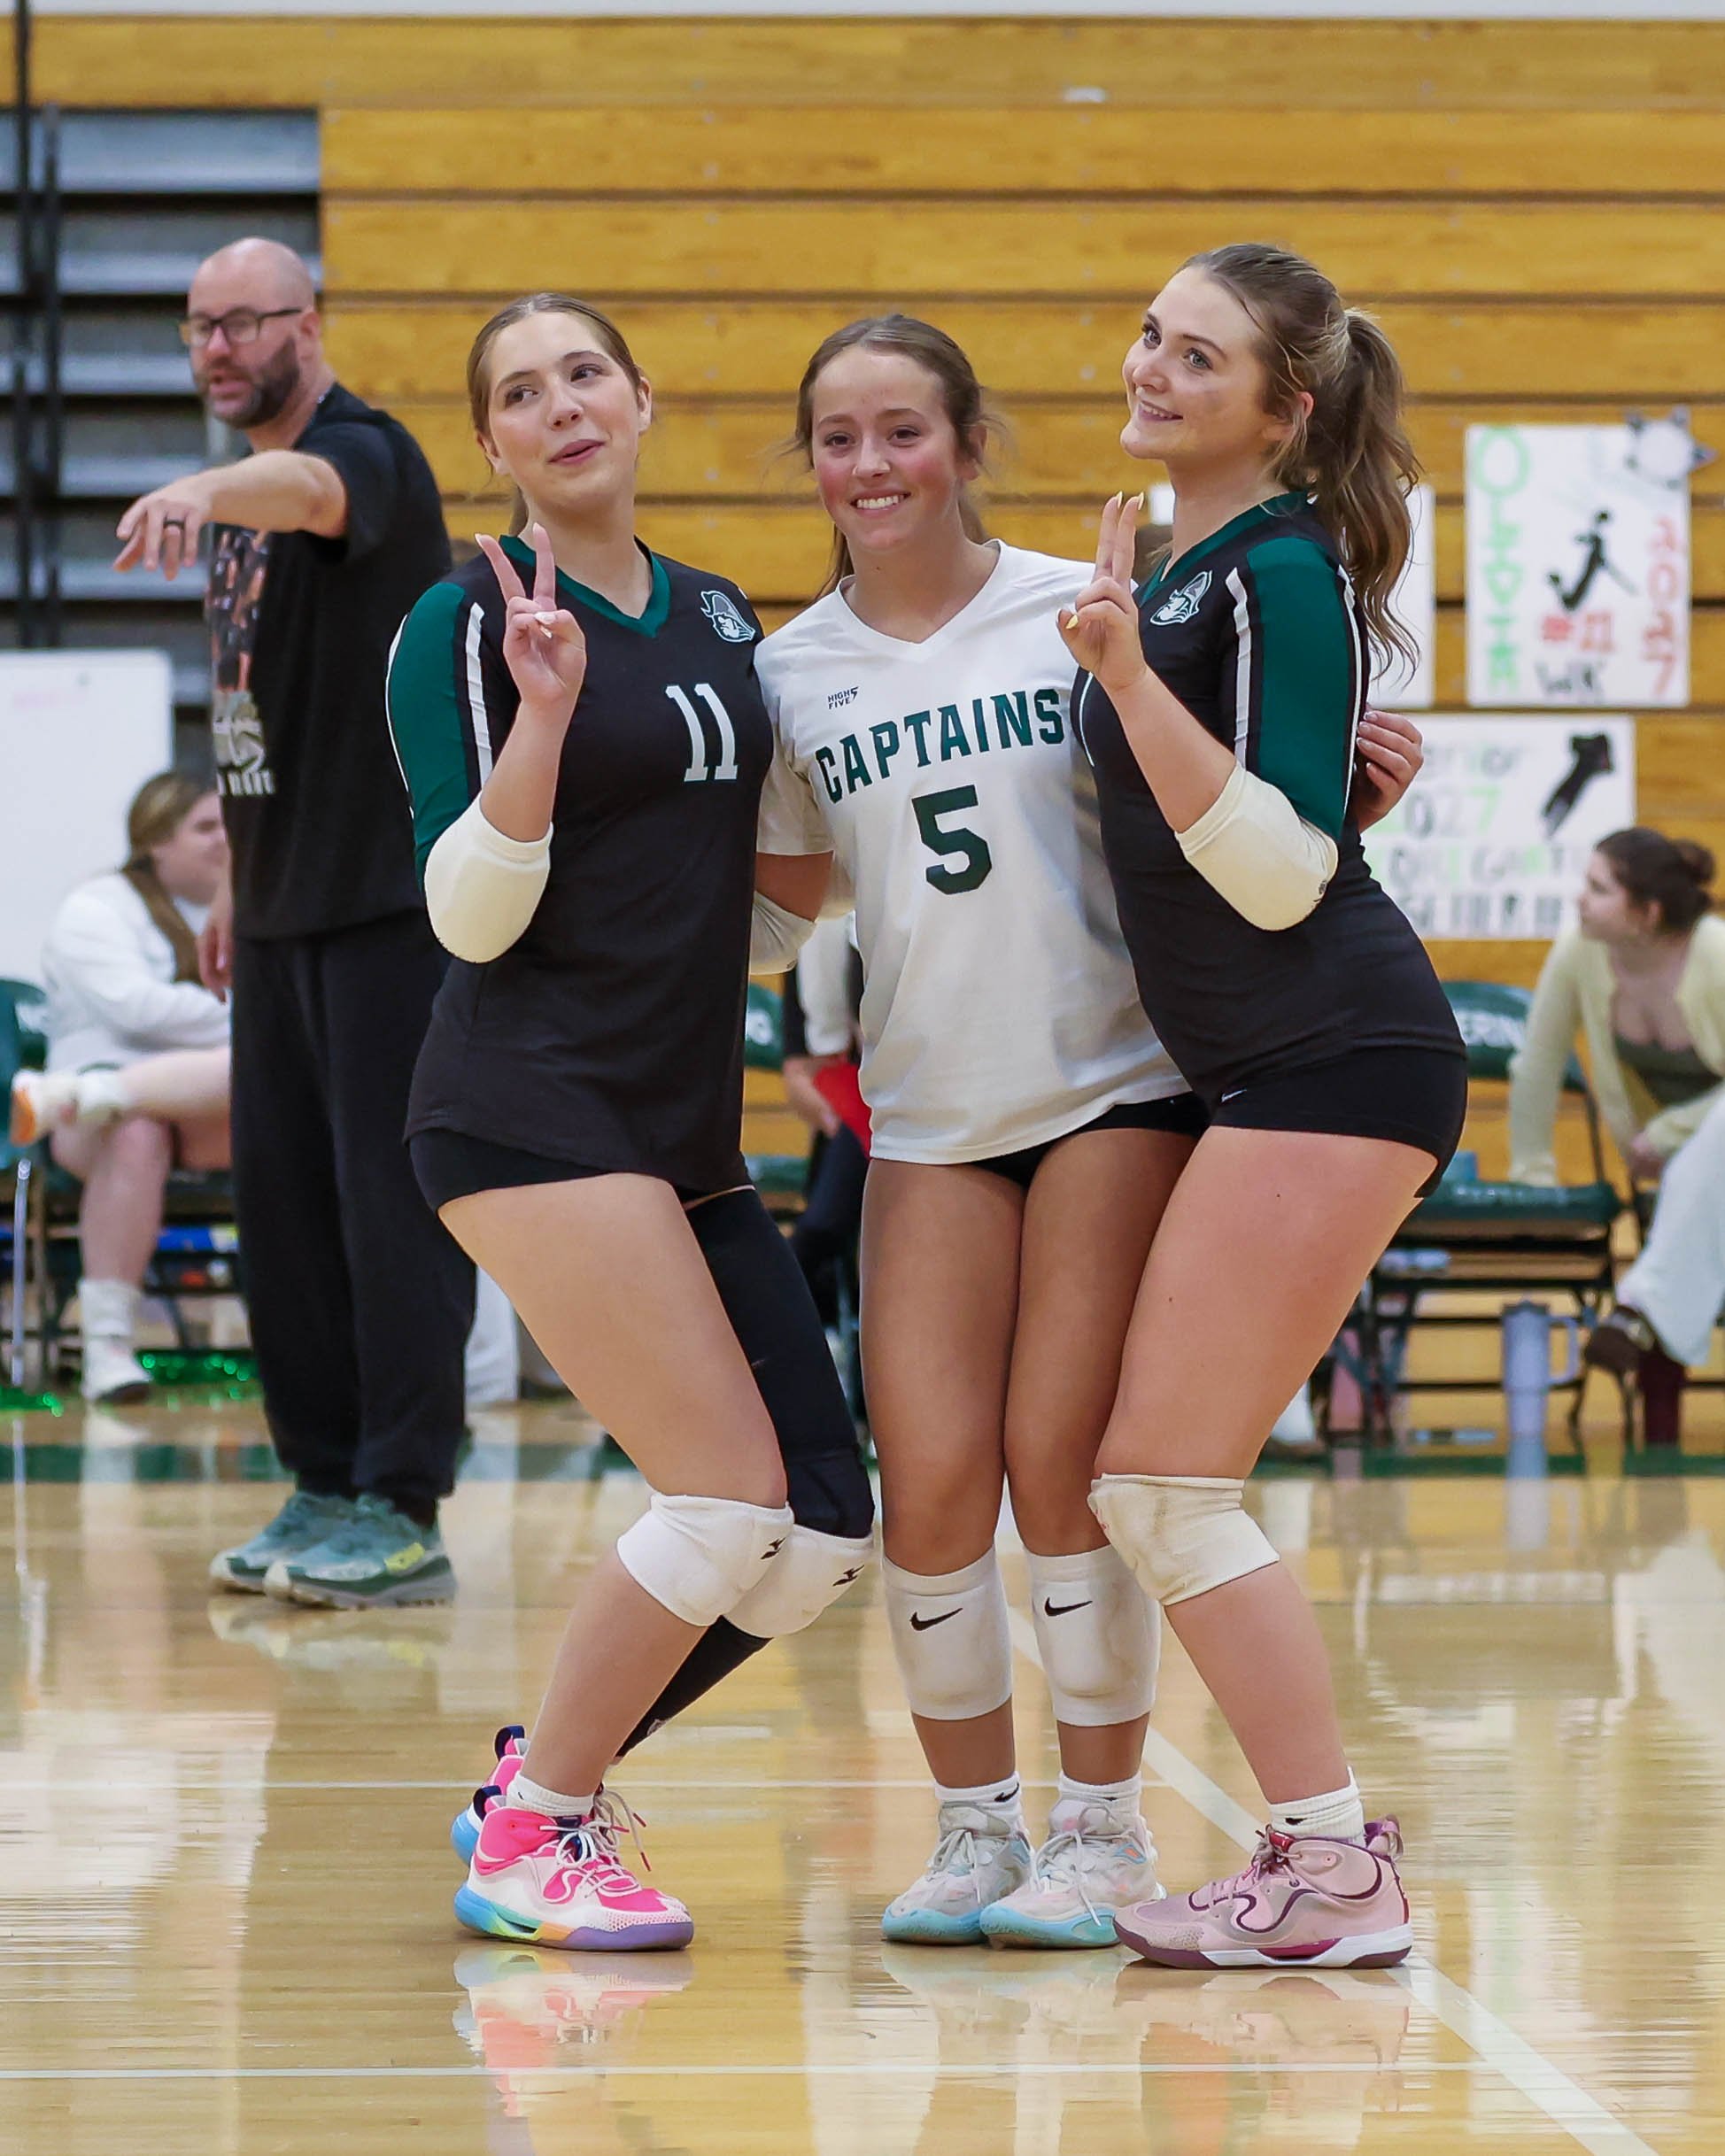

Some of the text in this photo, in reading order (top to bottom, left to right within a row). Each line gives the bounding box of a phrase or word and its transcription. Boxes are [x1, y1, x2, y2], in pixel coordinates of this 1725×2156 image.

[666, 683, 739, 783] 11
[816, 688, 1064, 803] CAPTAINS
[829, 697, 851, 710] FIVE
[911, 784, 993, 895] 5
